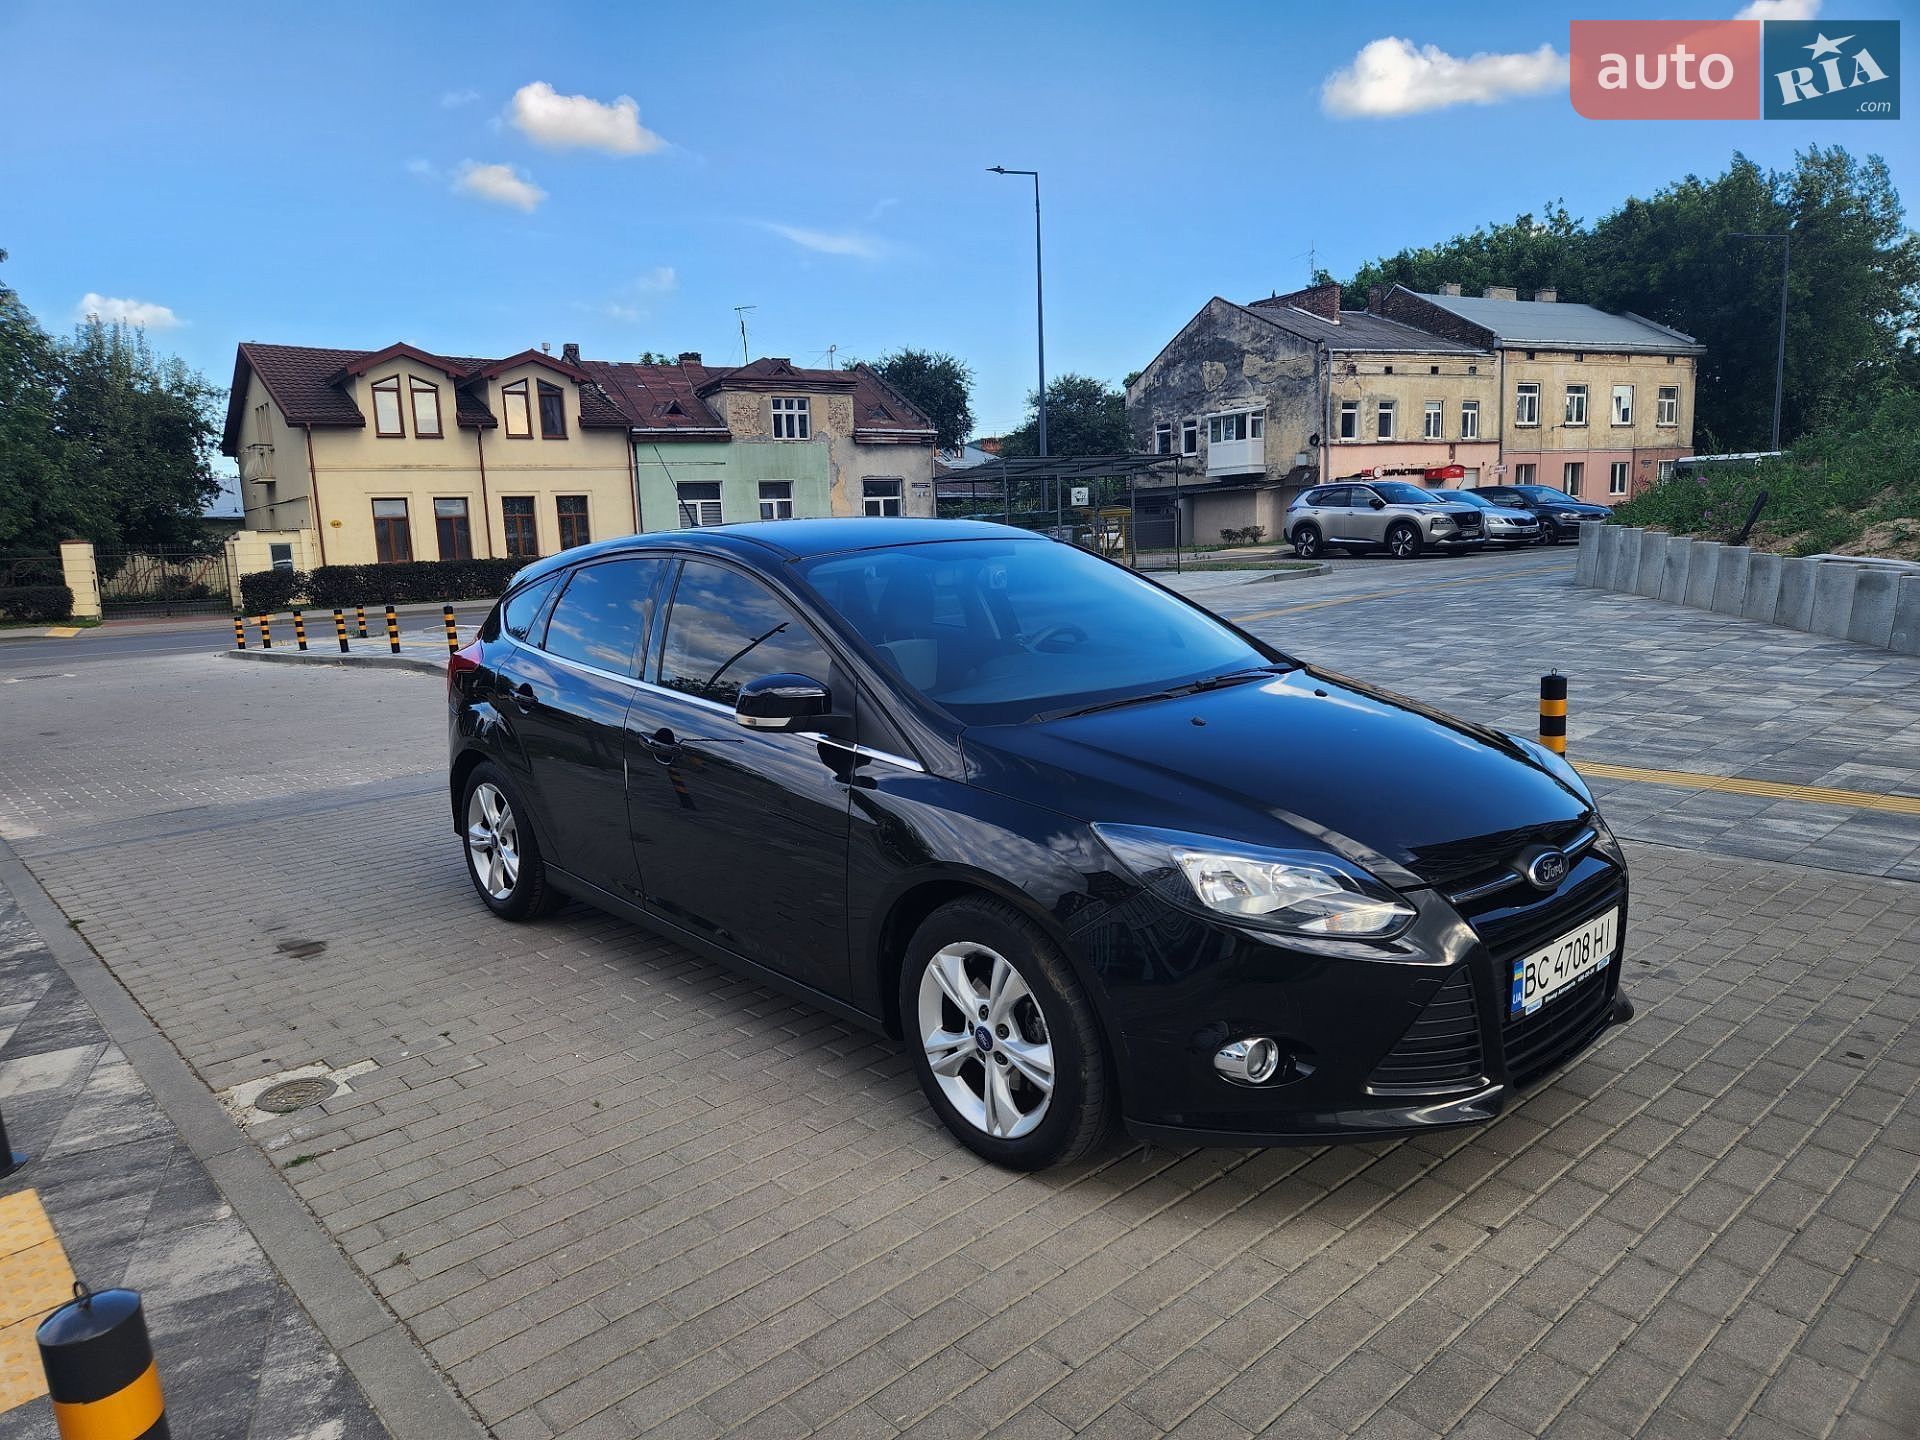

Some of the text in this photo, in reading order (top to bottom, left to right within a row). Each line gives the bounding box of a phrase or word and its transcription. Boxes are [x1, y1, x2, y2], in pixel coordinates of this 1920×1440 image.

[1542, 857, 1564, 880] Ford
[1524, 955, 1550, 999] BC
[1554, 931, 1591, 979] 4708
